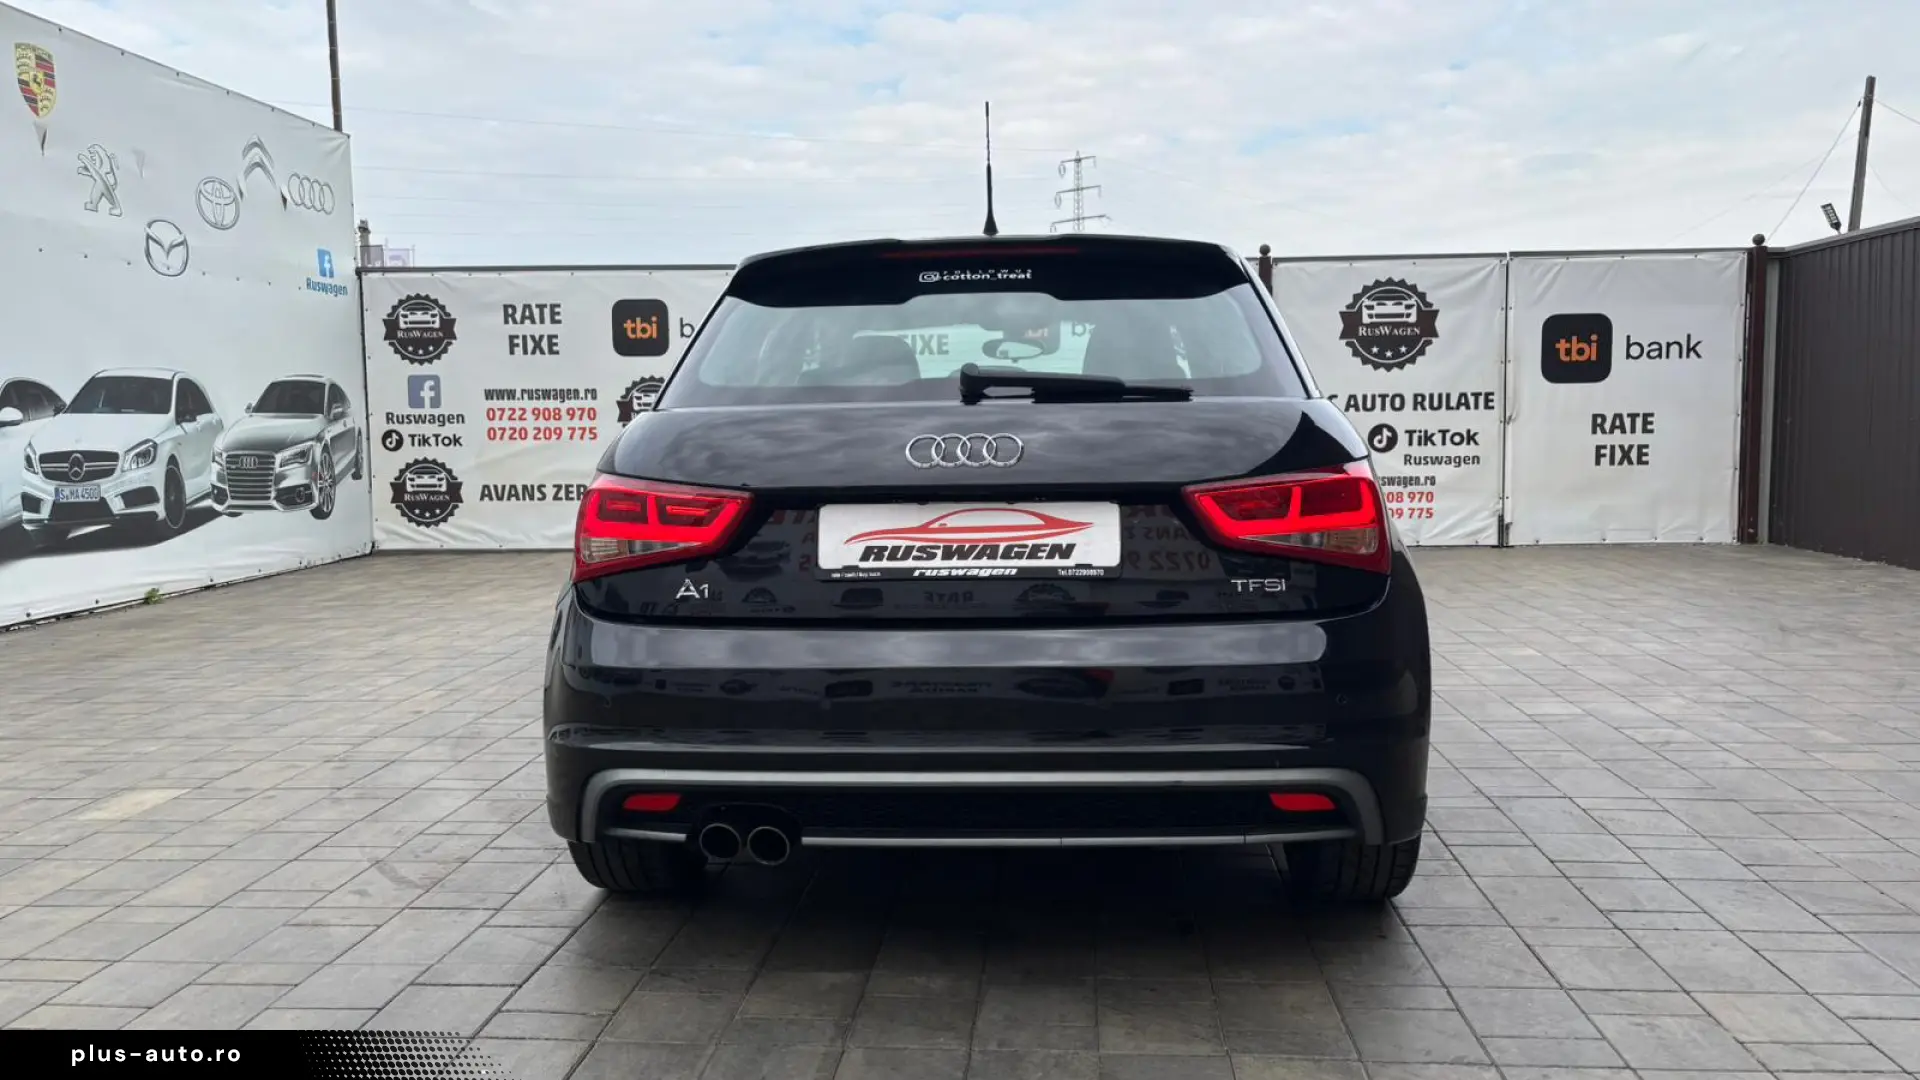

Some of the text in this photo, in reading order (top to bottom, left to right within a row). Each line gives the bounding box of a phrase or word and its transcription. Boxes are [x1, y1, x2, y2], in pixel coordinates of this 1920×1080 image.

[306, 277, 348, 297] Ruswagen
[502, 303, 562, 325] RATE
[623, 316, 659, 340] tbi
[508, 333, 560, 356] FIXE
[1554, 334, 1703, 363] tbi bank
[484, 388, 598, 403] www.ruswagen.ro
[1344, 391, 1495, 412] AUTO RULATE
[385, 412, 465, 426] Ruswagen
[486, 407, 597, 421] 0722 908 970
[1590, 412, 1655, 435] RATE
[408, 432, 463, 448] TikTok
[487, 427, 598, 441] 0720 209 775
[1404, 428, 1480, 447] TikTok
[1403, 454, 1481, 468] Ruswagen
[1595, 444, 1650, 467] FIXE
[1380, 475, 1436, 489] swagen.ro
[479, 483, 588, 502] AVANS ZER
[1386, 491, 1434, 504] 08 970
[1408, 507, 1434, 520] 775
[858, 543, 1077, 562] RUSWAGEN
[912, 567, 1018, 577] ruswagen
[675, 578, 709, 599] A1
[1231, 578, 1286, 592] TFSI
